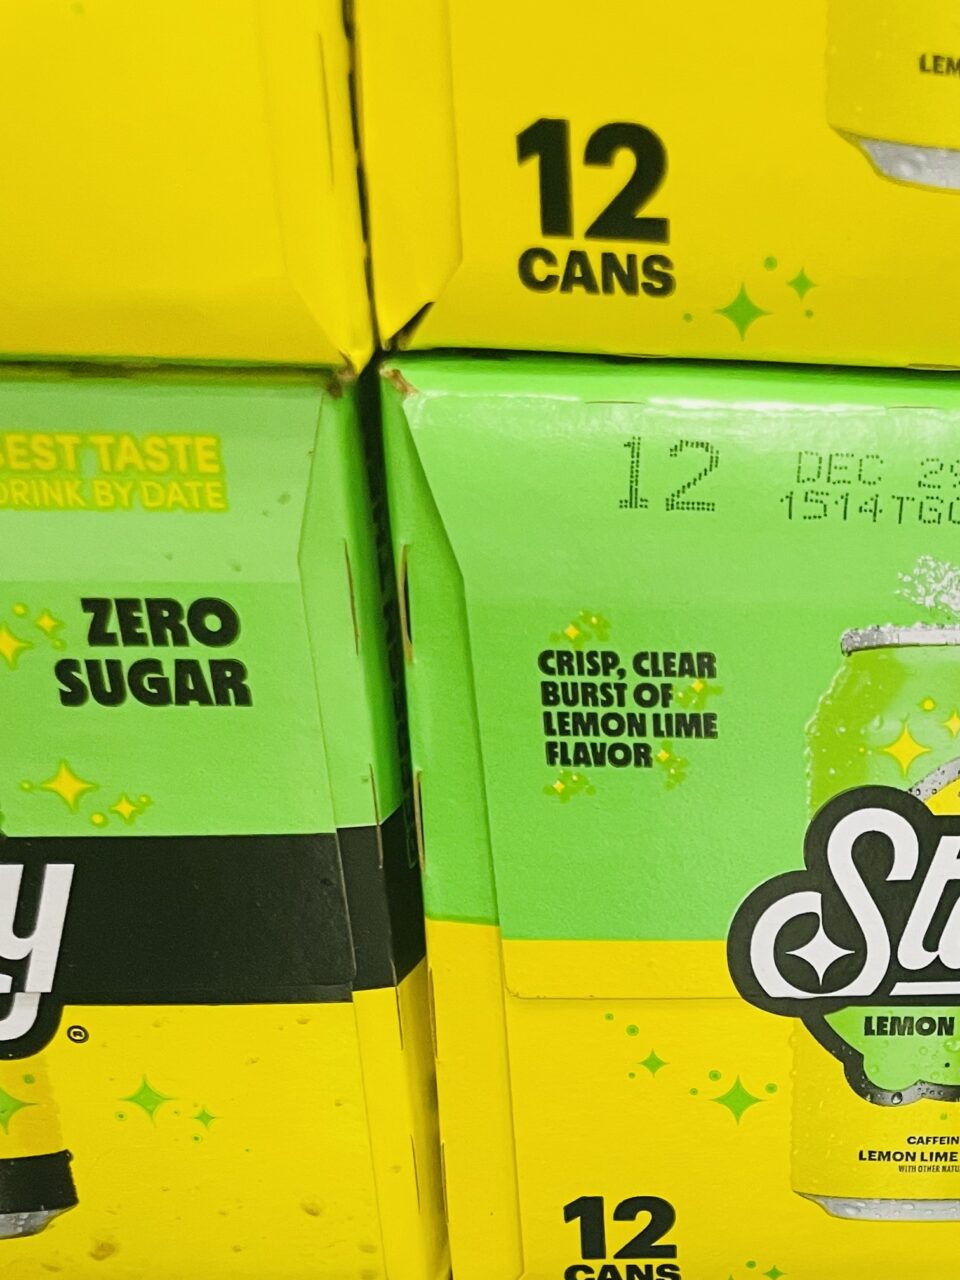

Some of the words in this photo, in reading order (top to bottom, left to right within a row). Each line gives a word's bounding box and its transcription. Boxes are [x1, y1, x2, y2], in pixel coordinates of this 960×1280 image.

[516, 117, 670, 244] 12
[517, 247, 676, 298] CANS
[0, 434, 80, 471] EST
[88, 435, 220, 473] TASTE
[796, 450, 884, 485] DEC
[619, 436, 719, 511] 12
[93, 480, 133, 507] BY
[140, 481, 225, 509] DATE
[80, 597, 241, 648] ZERO
[537, 649, 627, 680] CRISP,
[632, 651, 717, 678] CLEAR
[53, 658, 254, 708] SUGAR
[540, 681, 627, 707] BURST
[633, 683, 673, 708] OF
[542, 711, 647, 737] LEMON
[652, 712, 718, 739] LIME
[545, 741, 653, 768] FLAVOR
[864, 1016, 955, 1036] LEMON
[858, 1150, 915, 1162] LEMON
[920, 1151, 958, 1162] LIME
[898, 1165, 916, 1173] WITH
[918, 1165, 940, 1173] OTHER
[563, 1195, 677, 1260] 12
